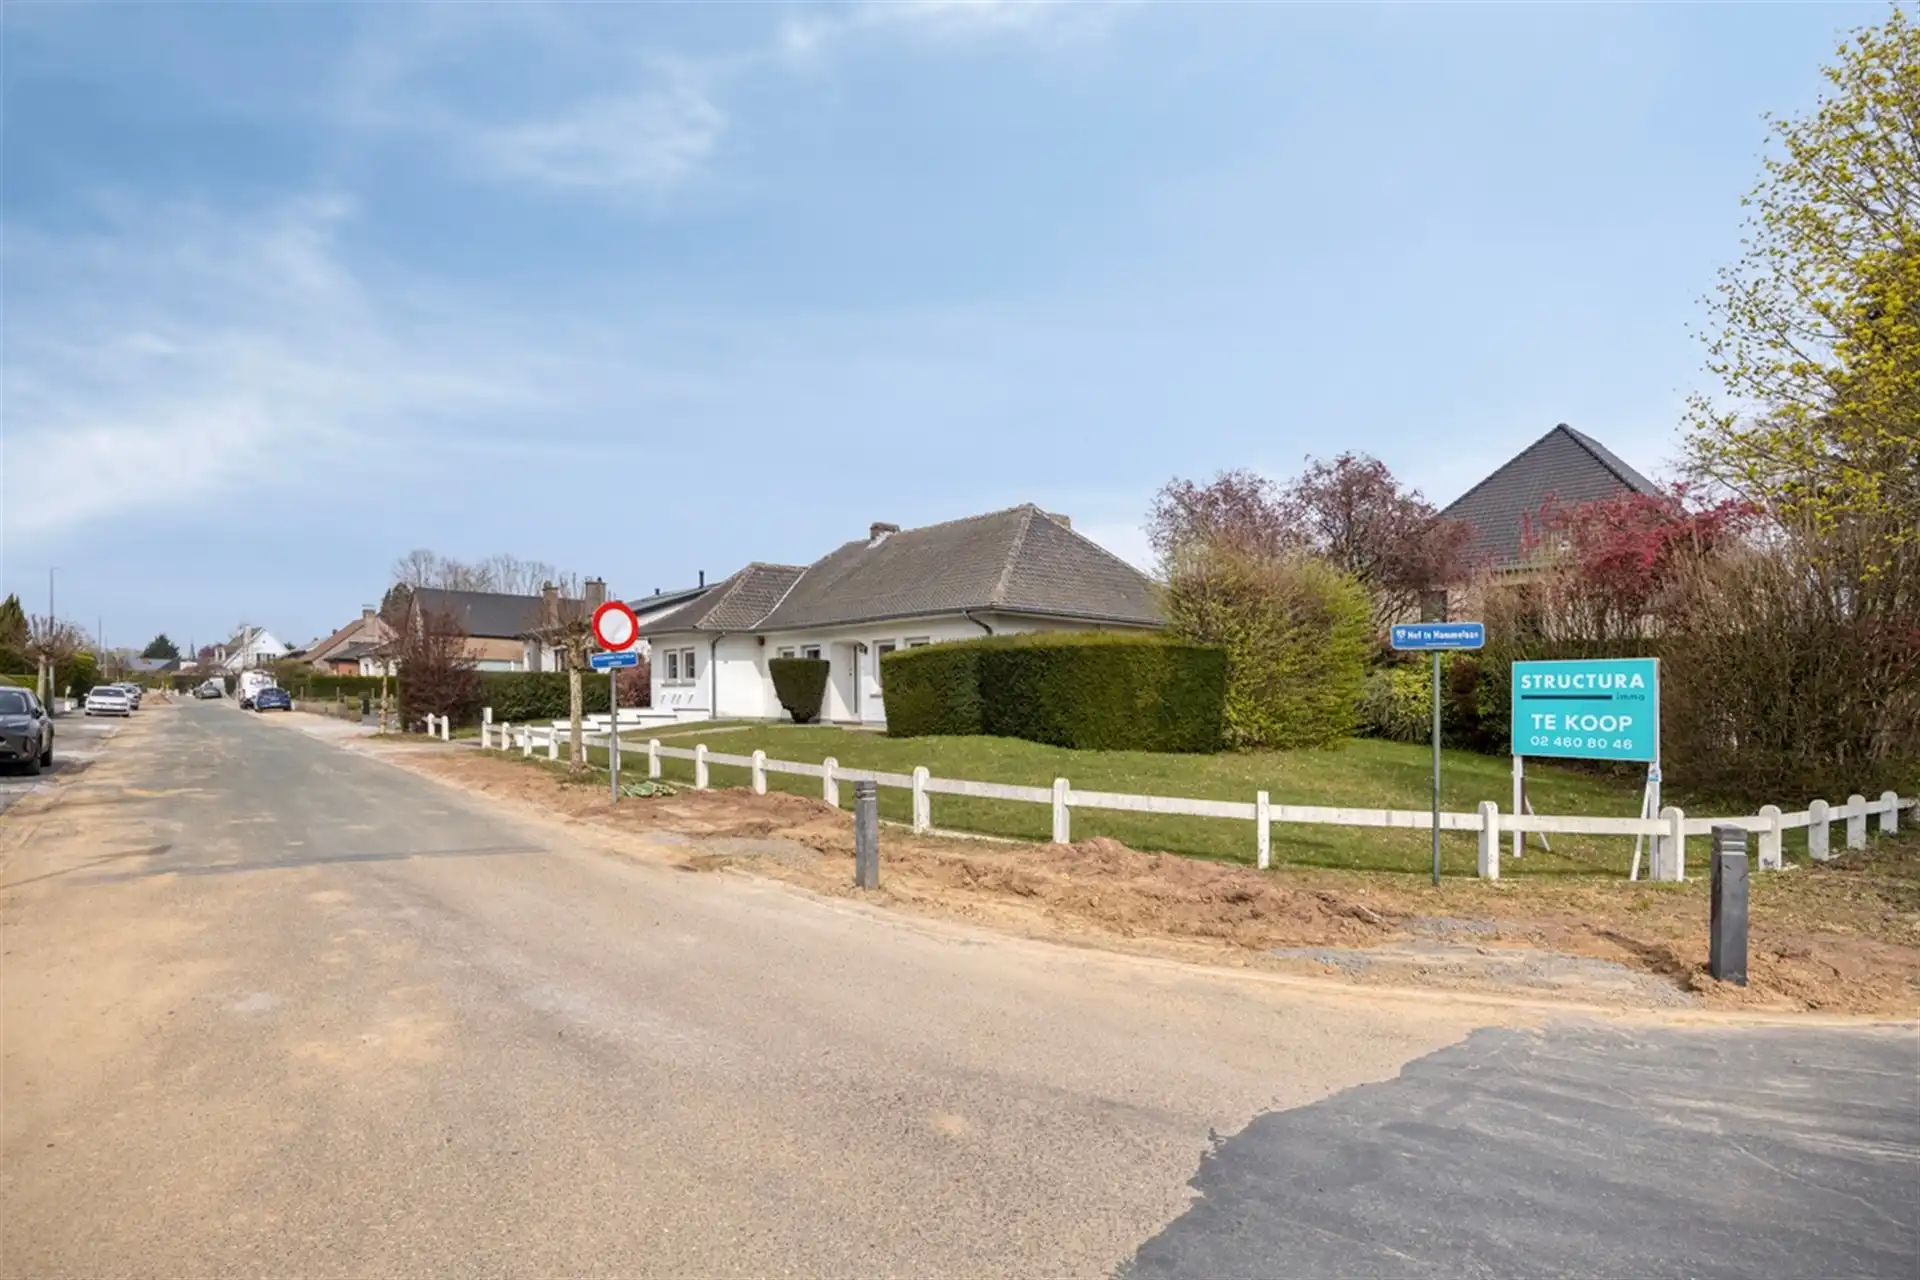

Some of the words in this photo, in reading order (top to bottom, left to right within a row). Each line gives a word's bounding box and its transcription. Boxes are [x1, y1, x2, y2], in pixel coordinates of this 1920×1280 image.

[1521, 673, 1645, 689] STRUCTURA
[1616, 692, 1645, 701] immo
[1530, 714, 1557, 731] TE
[1564, 714, 1633, 732] KOOP
[1530, 736, 1549, 747] 02
[1553, 736, 1583, 748] 460
[1586, 737, 1608, 749] 80
[1612, 739, 1633, 750] 46
